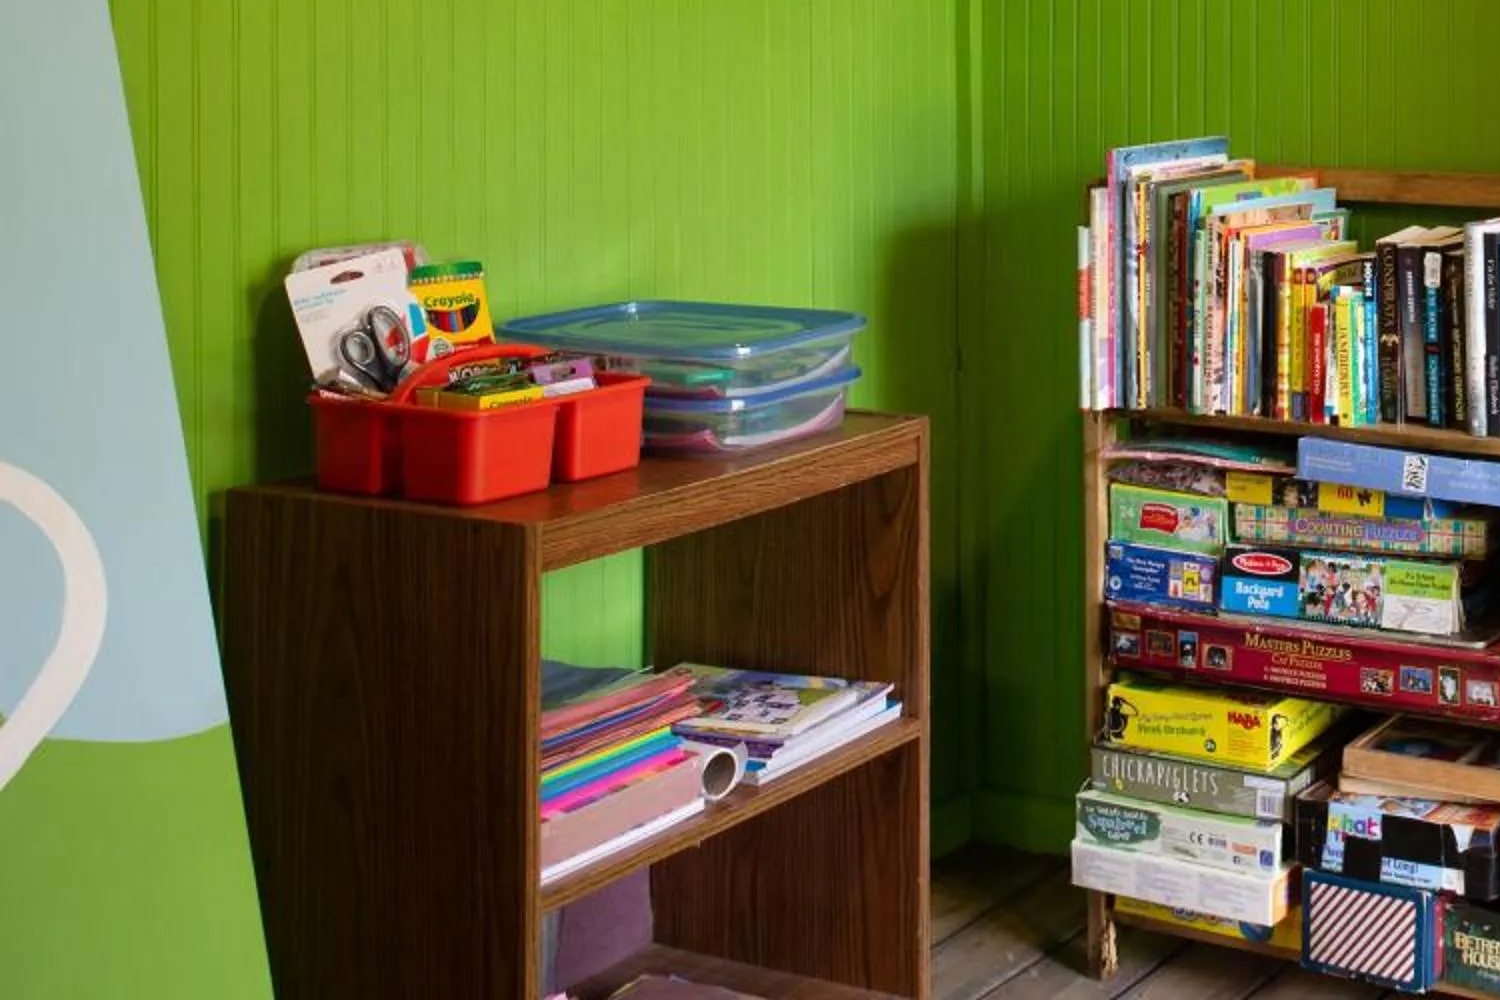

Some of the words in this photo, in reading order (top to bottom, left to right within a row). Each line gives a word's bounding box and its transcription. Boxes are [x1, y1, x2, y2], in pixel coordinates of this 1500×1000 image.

[1382, 247, 1396, 327] CONSPIRATA
[423, 291, 475, 309] Crayola
[1235, 581, 1284, 599] Backyard
[1227, 710, 1261, 731] HABA
[1101, 754, 1219, 797] CHICKAPIGLETS
